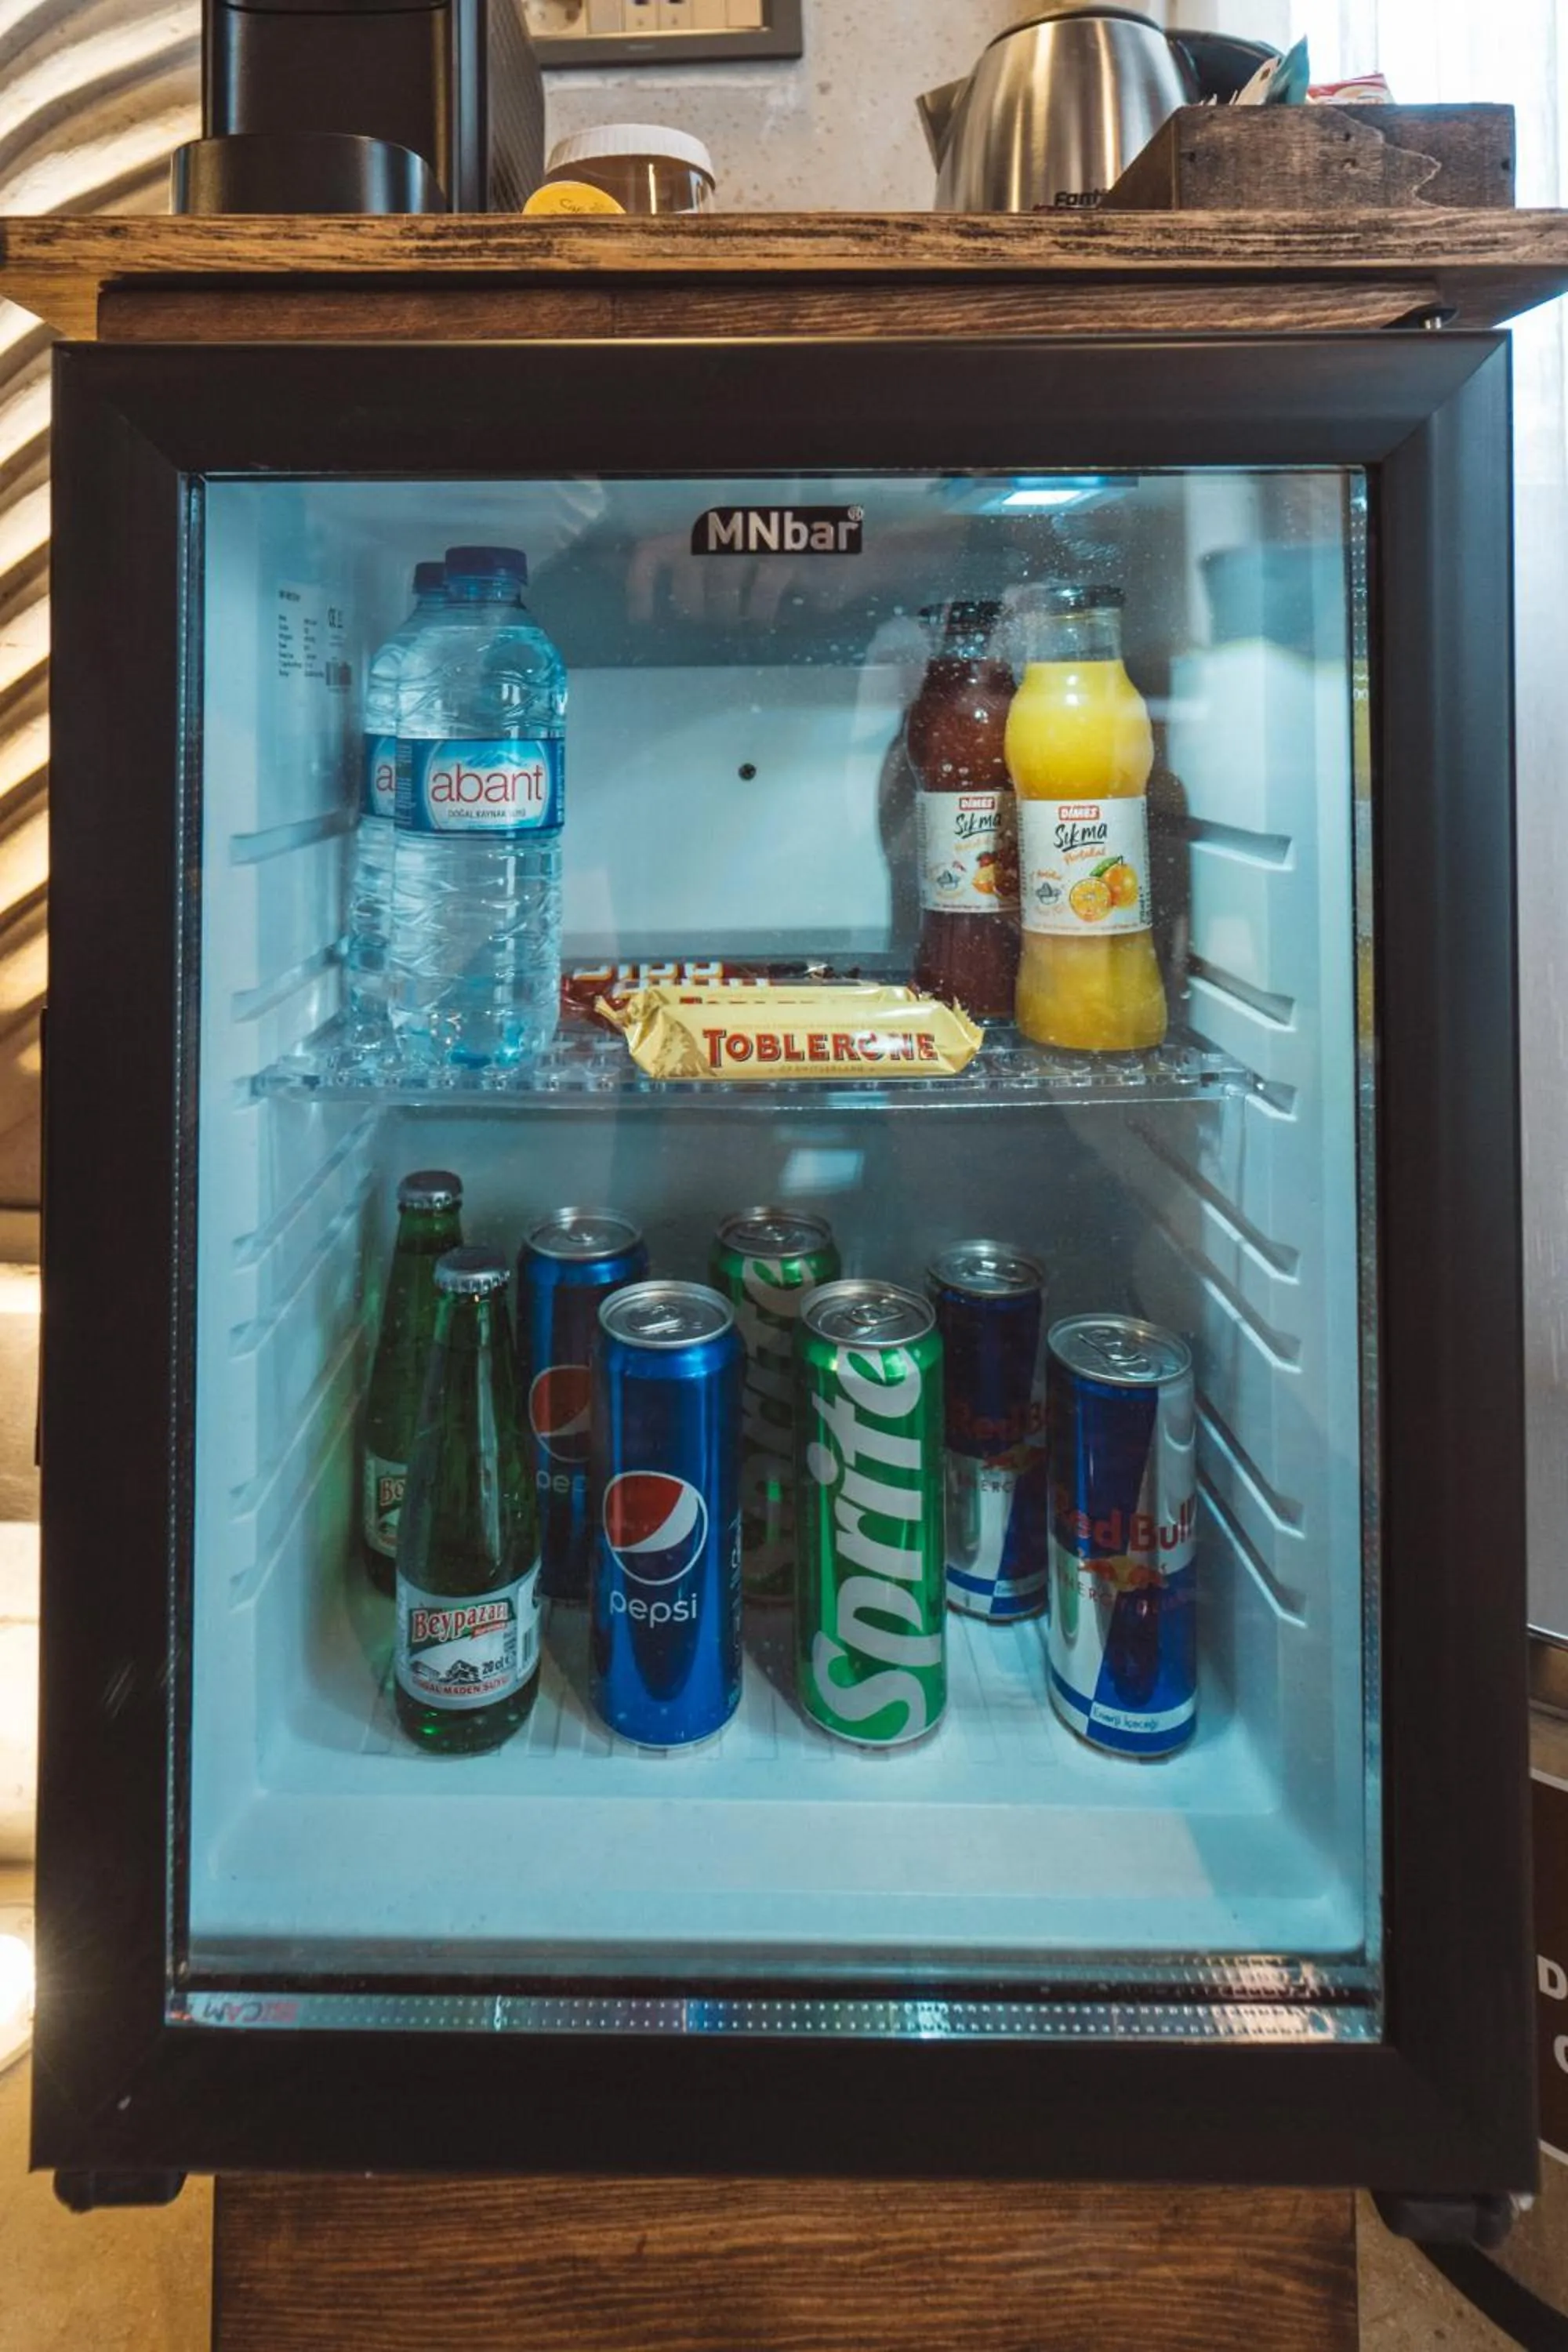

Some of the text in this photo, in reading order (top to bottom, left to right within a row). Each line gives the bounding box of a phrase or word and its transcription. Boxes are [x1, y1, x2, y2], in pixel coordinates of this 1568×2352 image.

[1054, 188, 1101, 205] Fant
[431, 763, 544, 803] abant
[702, 1028, 938, 1067] TOBLERONE
[536, 1471, 586, 1494] pep
[807, 1346, 941, 1740] Sprite
[610, 1590, 697, 1628] pepsi
